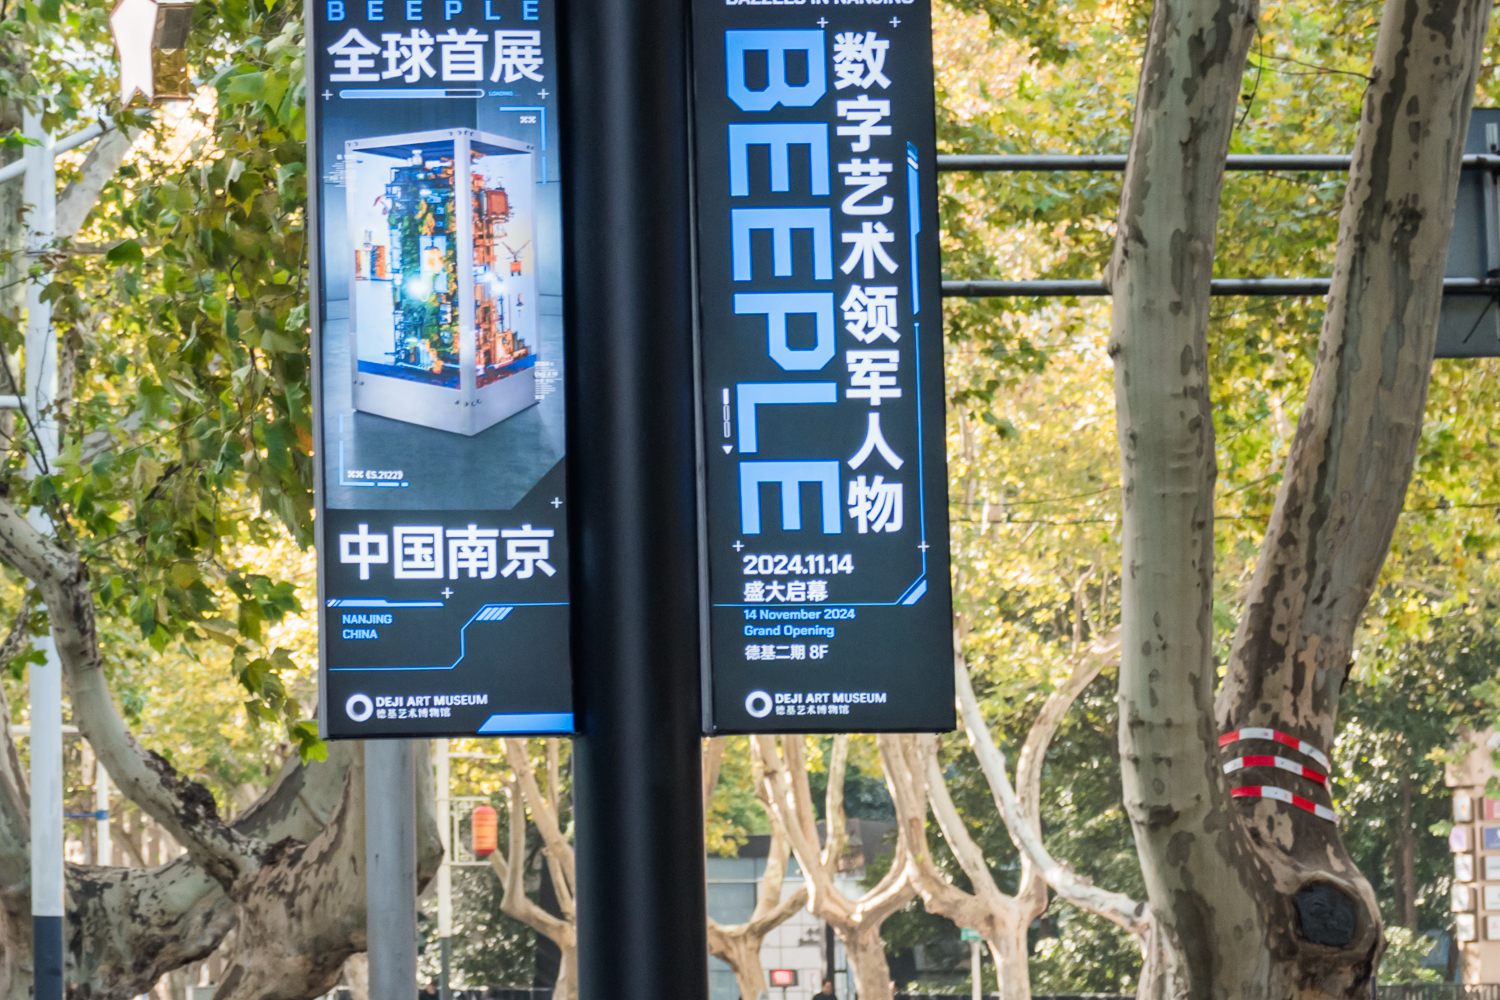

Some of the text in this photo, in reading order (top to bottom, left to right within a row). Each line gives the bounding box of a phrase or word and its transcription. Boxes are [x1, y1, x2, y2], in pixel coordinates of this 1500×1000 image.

[326, 0, 540, 21] BEEPLE
[327, 28, 545, 84] 全球首展
[725, 28, 842, 534] BEEPLE
[832, 31, 904, 534] 数字艺术领军人物
[339, 523, 557, 580] 中国南京
[743, 554, 854, 575] 2024.11.14
[744, 580, 829, 602] 盛大启幕
[342, 613, 393, 626] NANJING
[743, 608, 856, 620] 14 November 2024
[342, 628, 378, 640] CHINA
[744, 625, 836, 638] Grand Opening
[744, 644, 829, 660] 德基二期 8F
[376, 694, 488, 708] DEJI ART MUSEUM
[775, 692, 887, 704] DEJI ART MUSEUM
